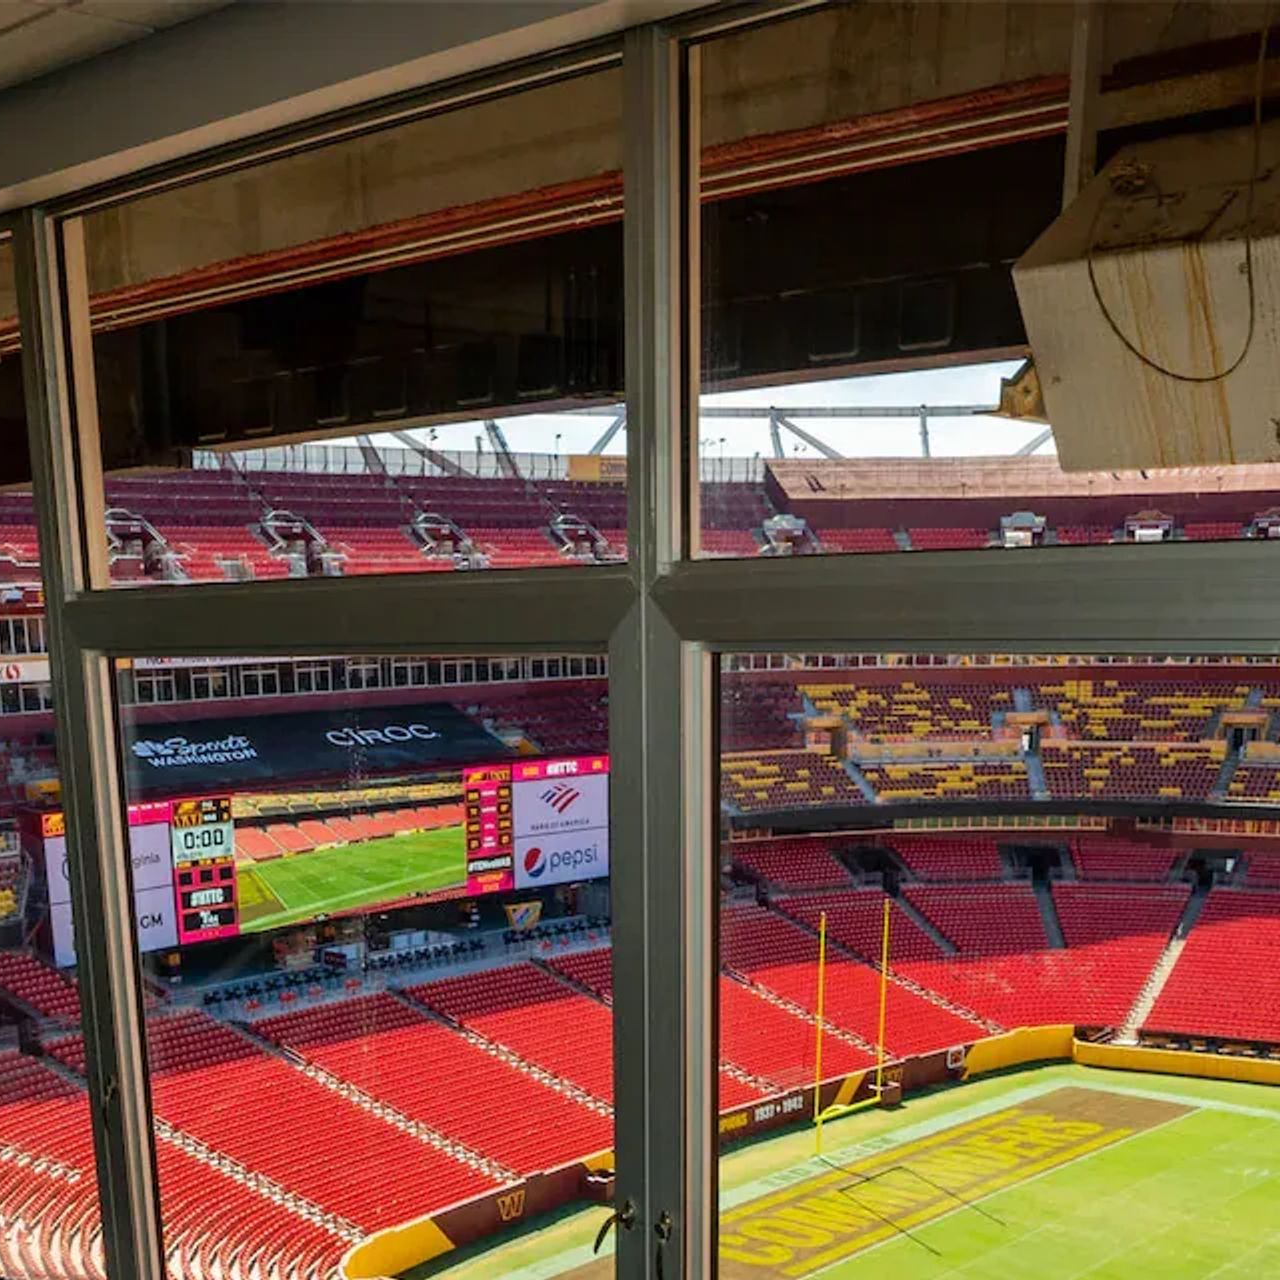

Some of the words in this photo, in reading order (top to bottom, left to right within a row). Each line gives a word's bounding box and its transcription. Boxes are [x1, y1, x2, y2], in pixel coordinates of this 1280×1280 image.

[148, 748, 257, 768] WASHINGTON
[183, 828, 224, 850] 0:00
[549, 843, 599, 873] pepsi
[719, 1113, 1105, 1267] COMMANDERS
